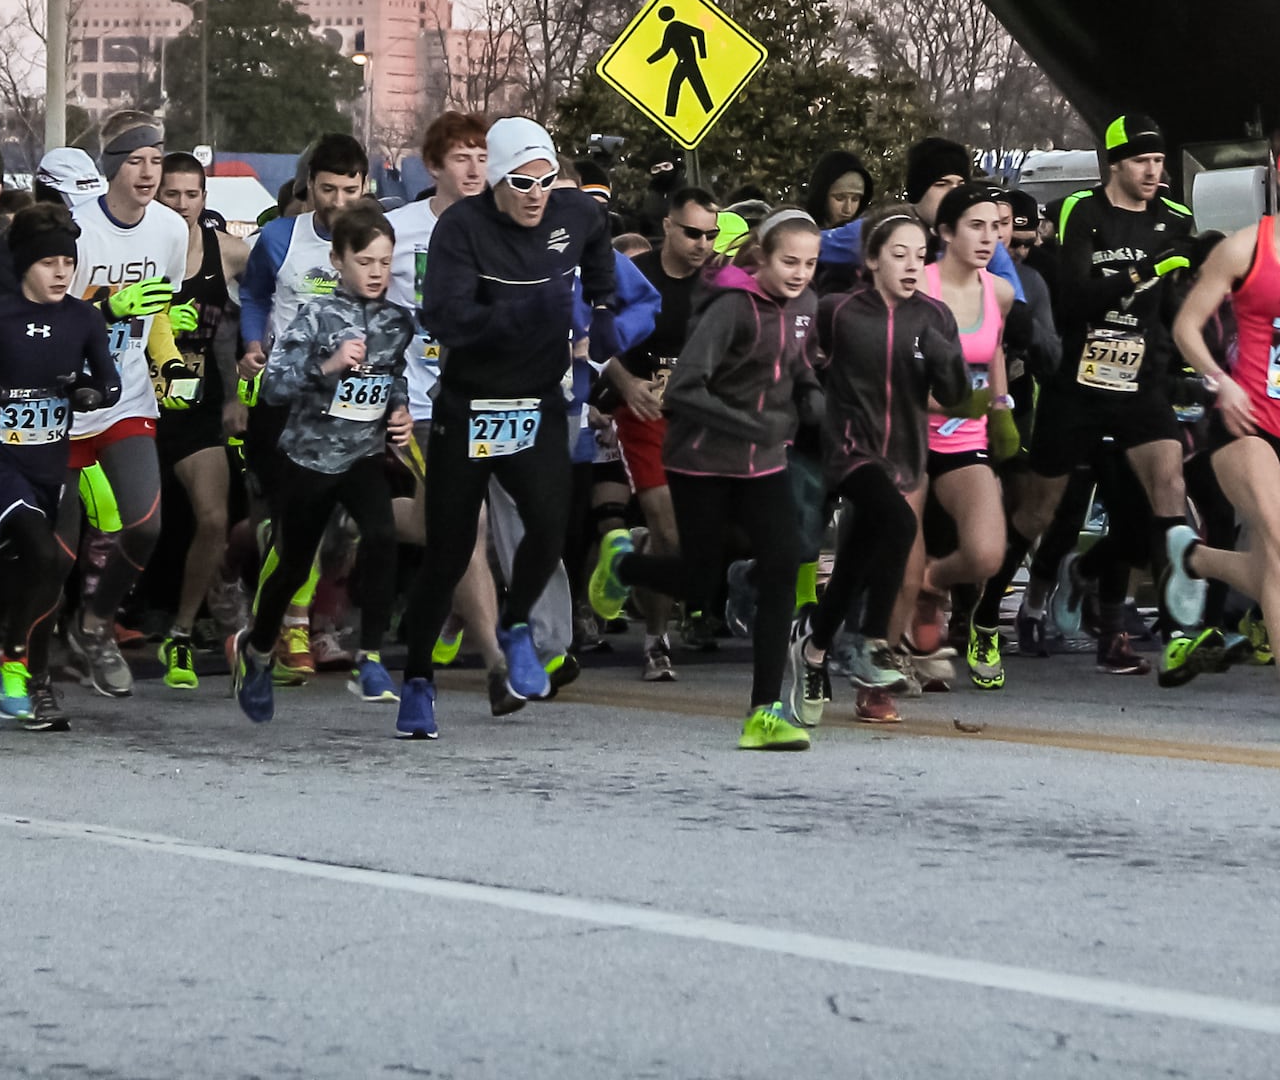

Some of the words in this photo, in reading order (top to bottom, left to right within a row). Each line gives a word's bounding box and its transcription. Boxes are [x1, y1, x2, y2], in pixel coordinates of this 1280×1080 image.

[89, 256, 156, 285] rush
[1087, 347, 1140, 367] 57147
[1085, 365, 1095, 375] A
[339, 381, 391, 405] 3683
[4, 407, 67, 429] 3219
[9, 431, 21, 443] A
[474, 419, 537, 441] 2719
[477, 444, 489, 456] A
